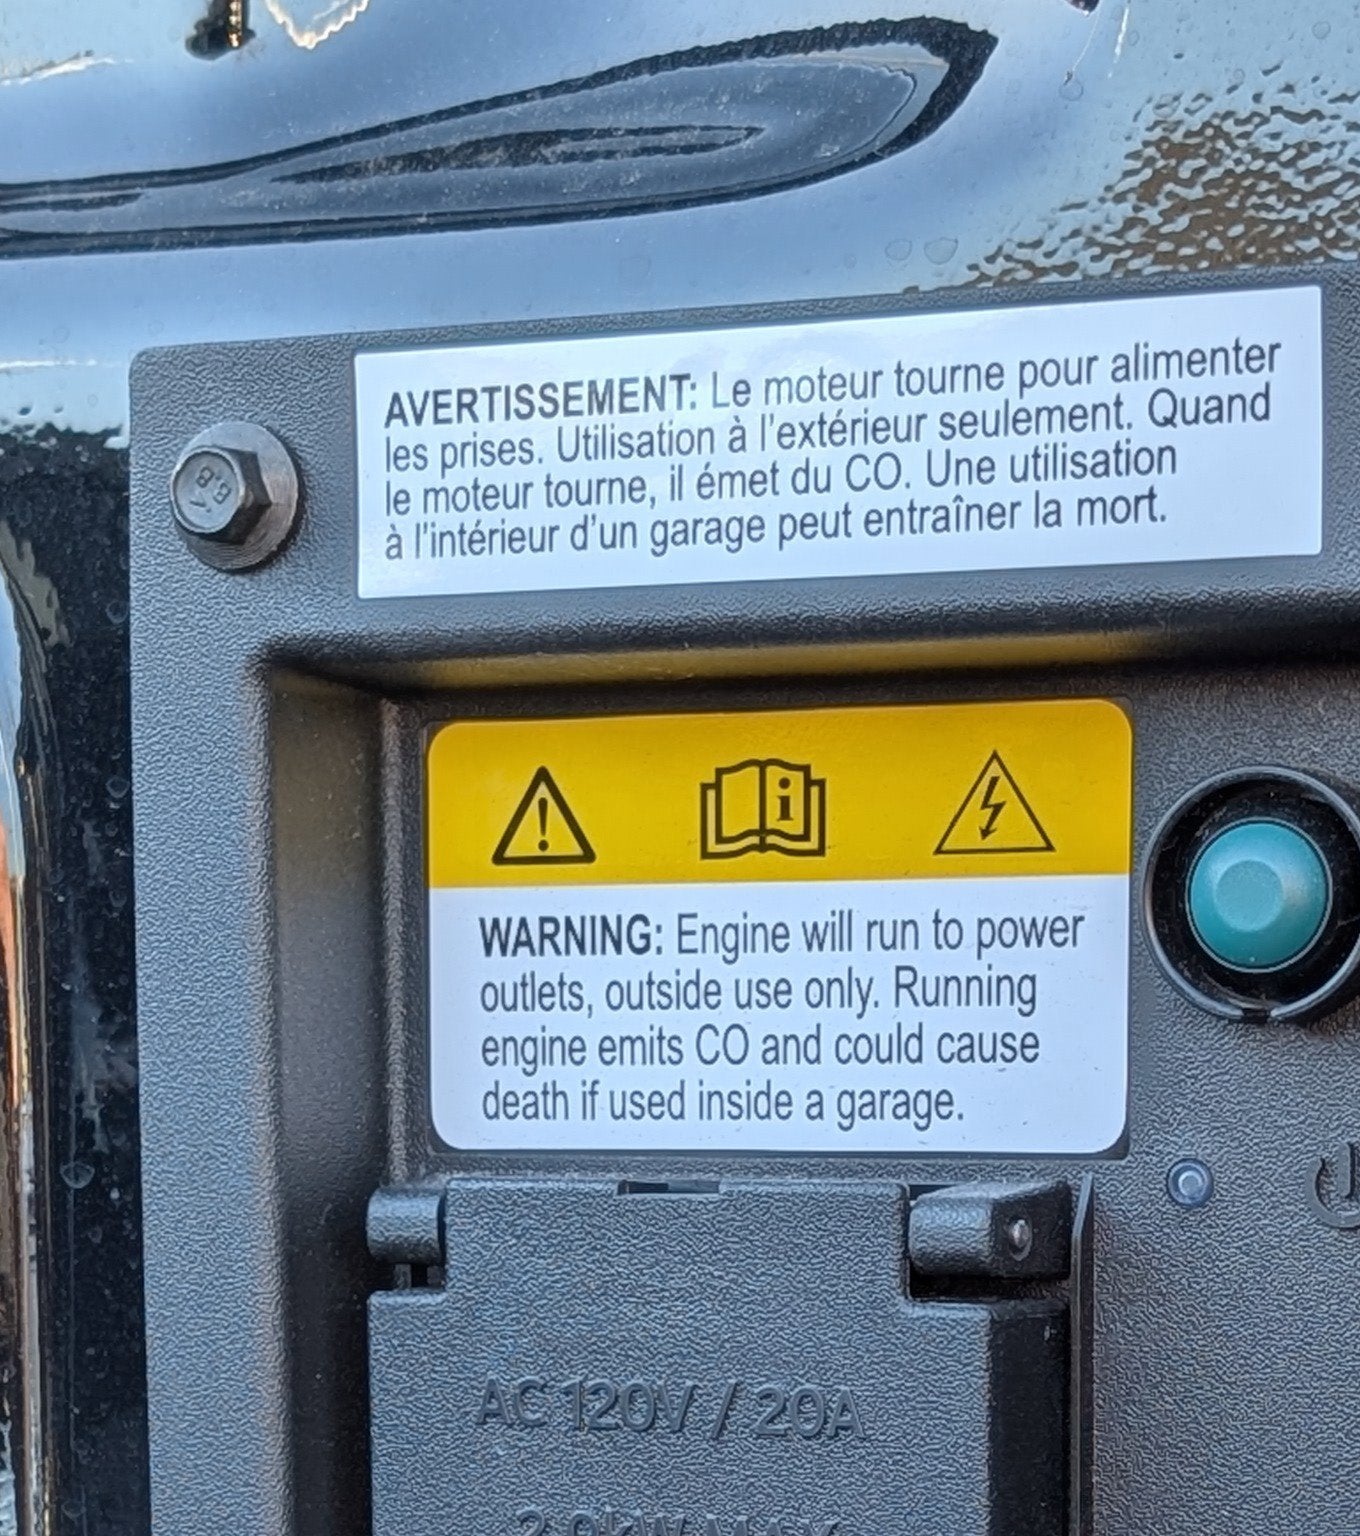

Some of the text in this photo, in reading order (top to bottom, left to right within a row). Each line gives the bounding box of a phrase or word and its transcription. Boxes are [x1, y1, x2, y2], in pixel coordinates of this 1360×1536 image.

[385, 337, 1281, 428] AVERTISSEMENT: Le moteur tourne pour alimenter
[386, 381, 1270, 479] les prises. Utilisation à l'extérieur seulement. Quand
[386, 438, 1176, 516] le moteur tourne, il émet du CO. Une utilisation
[386, 485, 1166, 560] à l'intérieur d'un garage peut entraîner la mort.
[479, 909, 1085, 965] WARNING: Engine will run to power
[481, 964, 1036, 1019] outlets, outside use only. Running
[482, 1022, 1039, 1077] engine emits CO and could cause
[483, 1079, 963, 1132] death if used inside a garage.
[476, 1373, 546, 1426] AC
[561, 1378, 697, 1433] 120V
[753, 1386, 866, 1439] 20A
